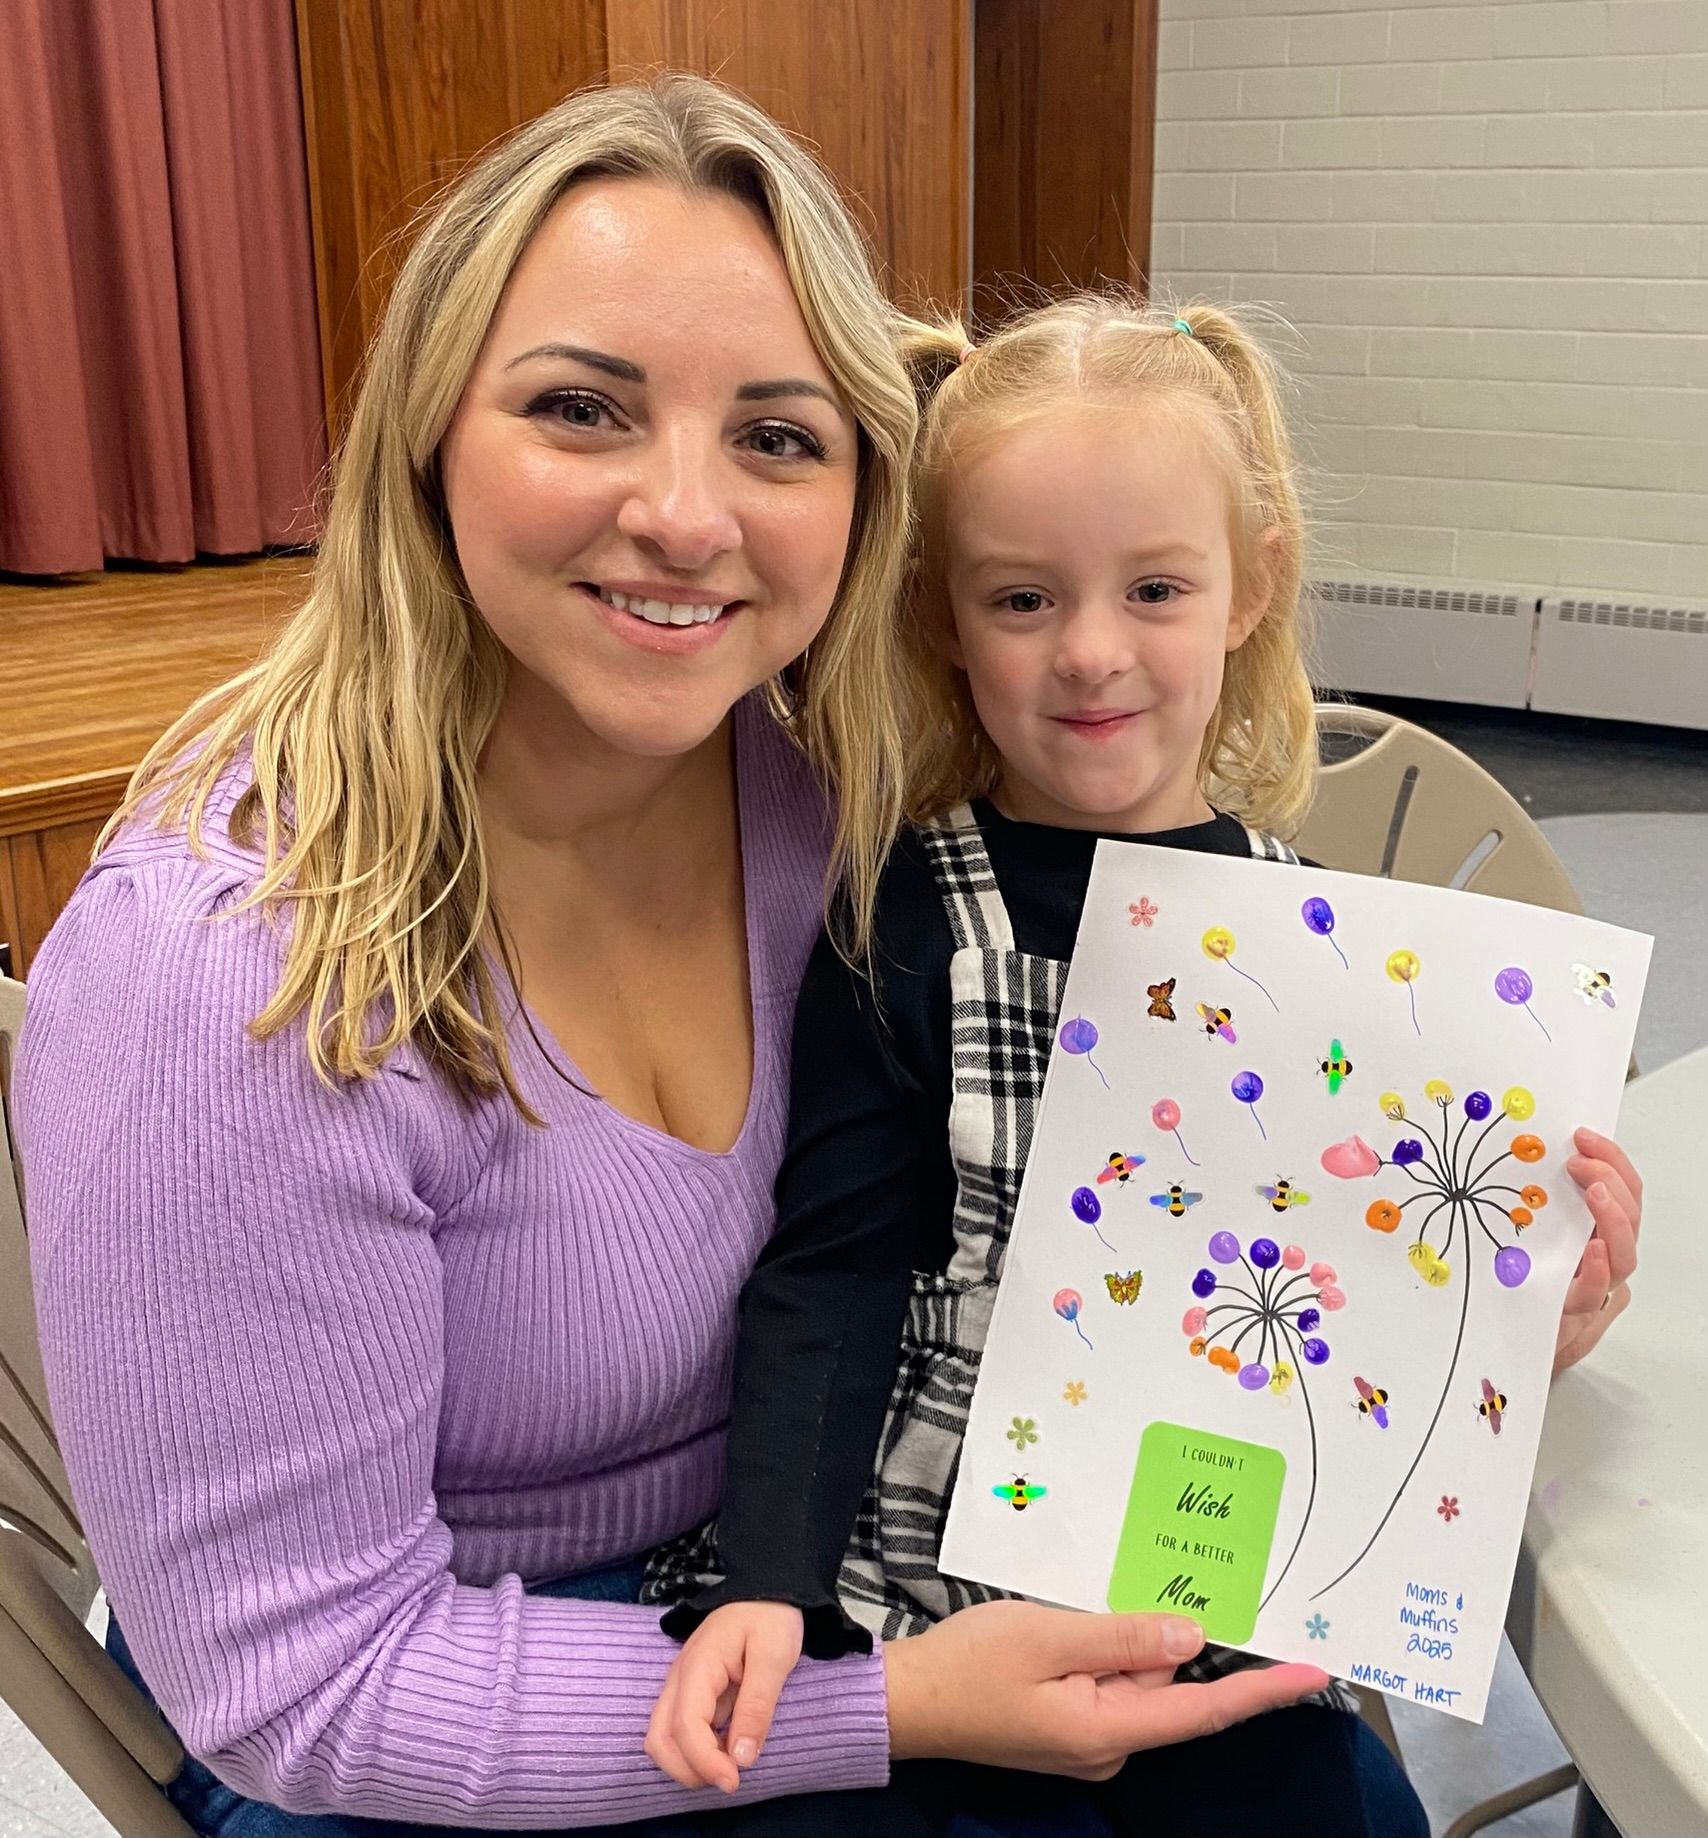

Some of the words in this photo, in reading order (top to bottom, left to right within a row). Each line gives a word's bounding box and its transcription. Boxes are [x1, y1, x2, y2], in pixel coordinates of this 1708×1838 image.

[1182, 1445, 1187, 1458] I
[1191, 1448, 1245, 1471] COULDN'T
[1176, 1482, 1233, 1519] Wish
[1155, 1533, 1177, 1550] FOR
[1181, 1540, 1188, 1553] A
[1193, 1543, 1235, 1565] BETTER
[1156, 1574, 1211, 1611] Mom
[1406, 1582, 1448, 1606] Moms
[1400, 1607, 1458, 1634] Muffins
[1406, 1633, 1452, 1660] 2025
[1350, 1664, 1408, 1693] MARGOT
[1415, 1682, 1461, 1707] HART
